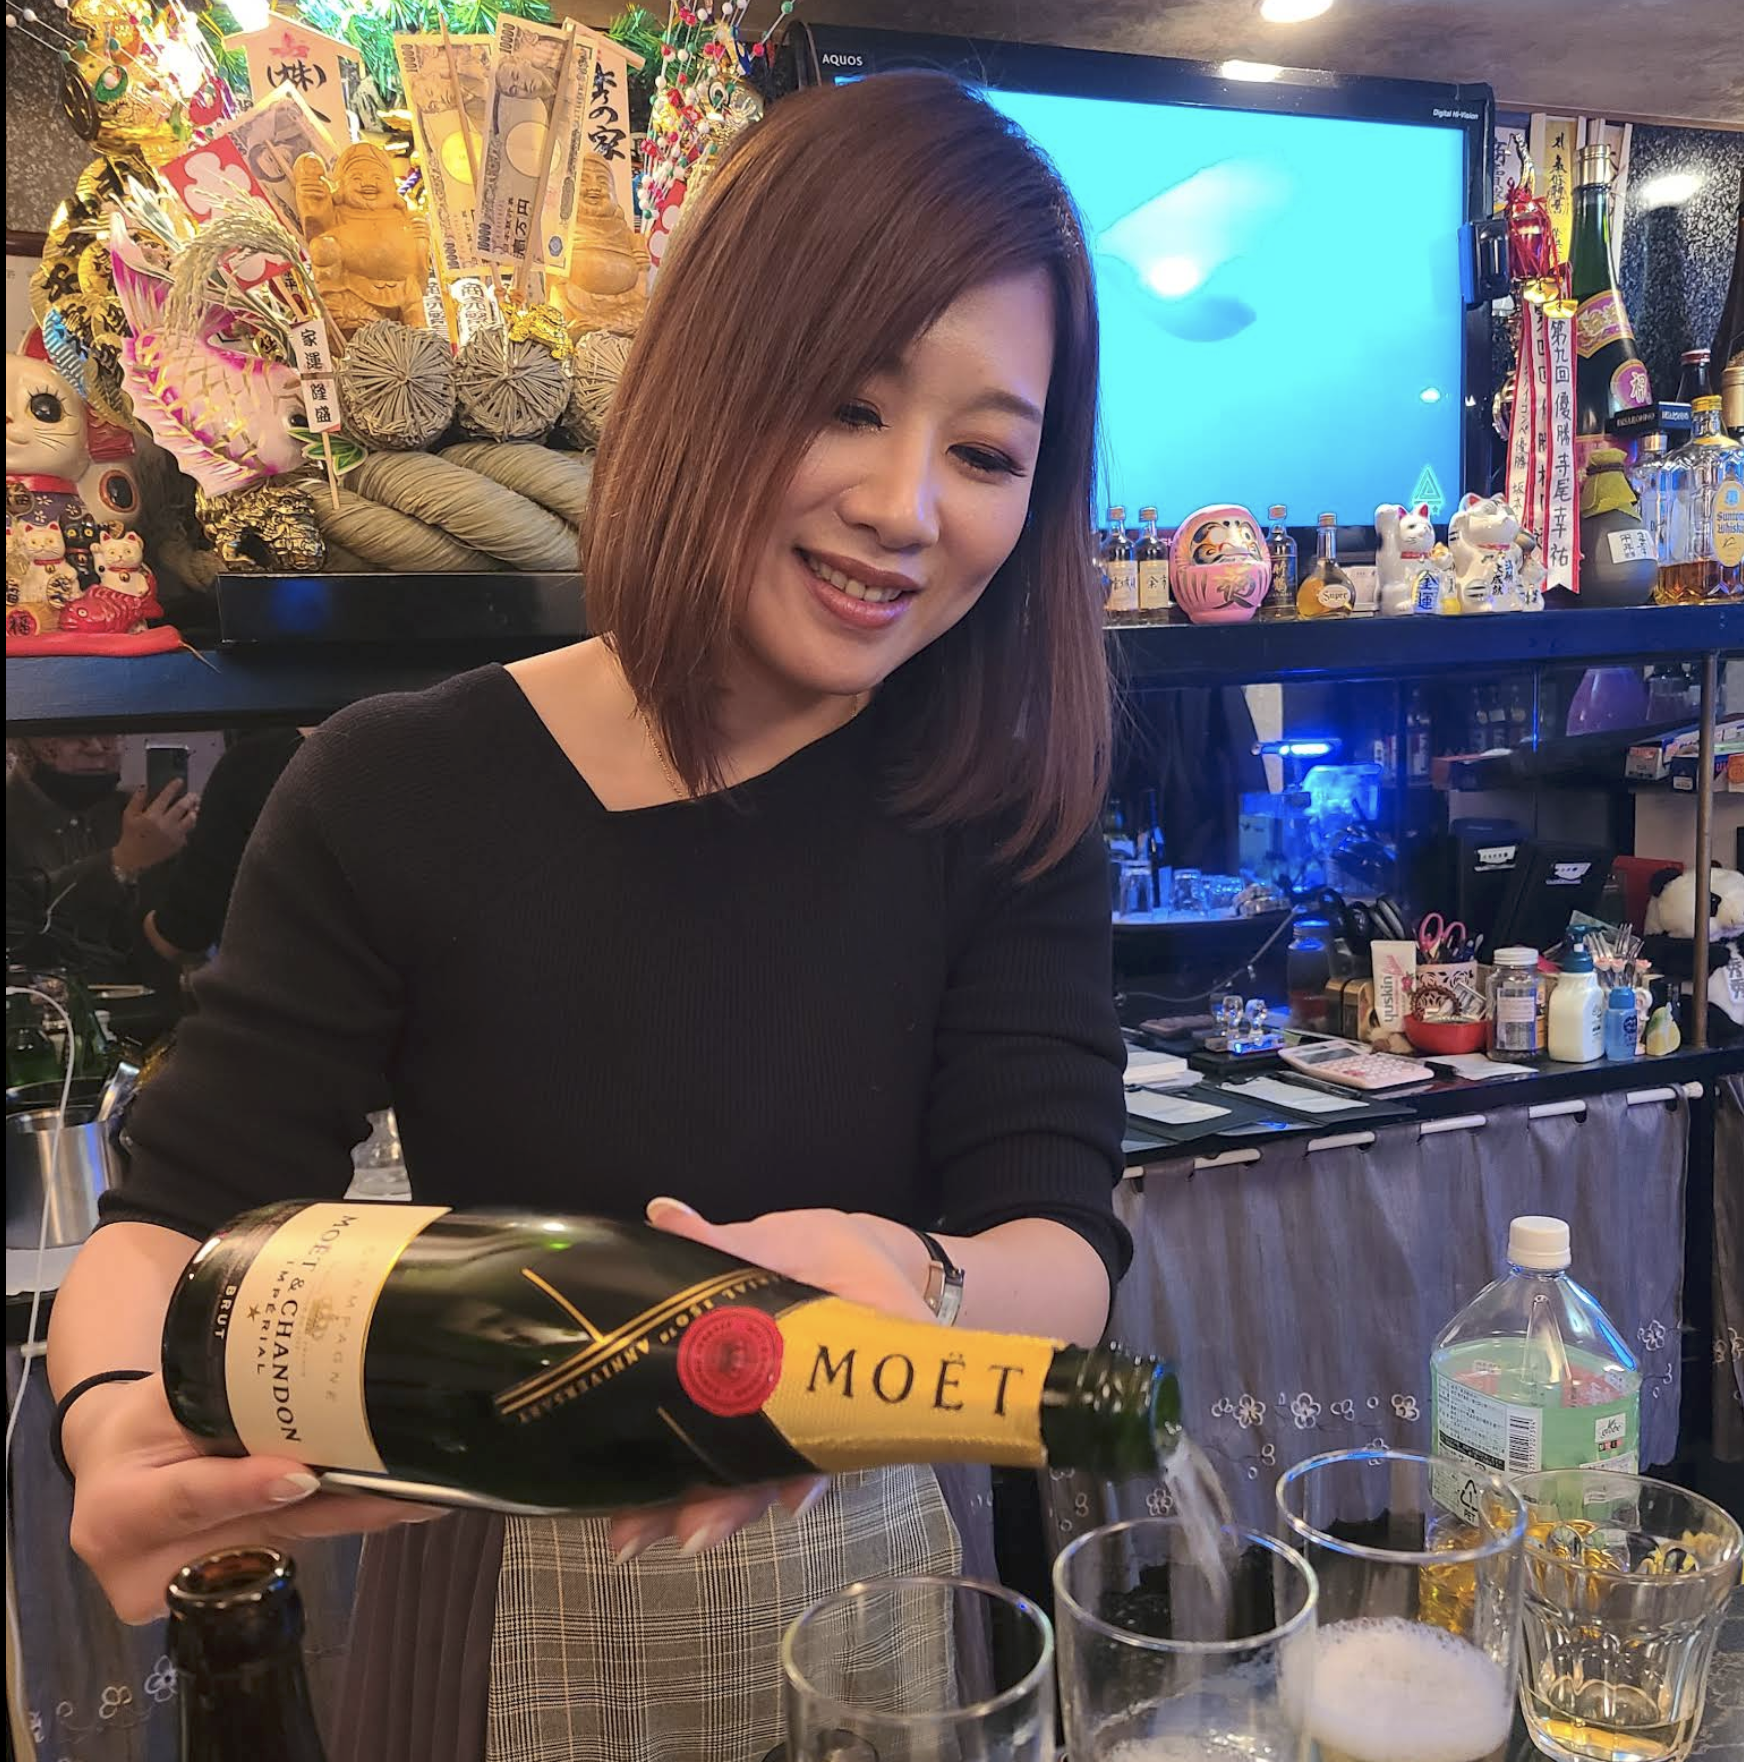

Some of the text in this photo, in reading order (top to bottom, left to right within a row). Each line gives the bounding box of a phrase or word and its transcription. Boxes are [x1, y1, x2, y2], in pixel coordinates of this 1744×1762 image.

[822, 54, 863, 67] AQUOS
[1432, 108, 1452, 118] Digital
[287, 1276, 305, 1292] &
[215, 1285, 238, 1340] BRUT
[272, 1299, 302, 1442] CHANDON
[806, 1344, 1024, 1418] MOËT
[1463, 1508, 1477, 1523] PET
